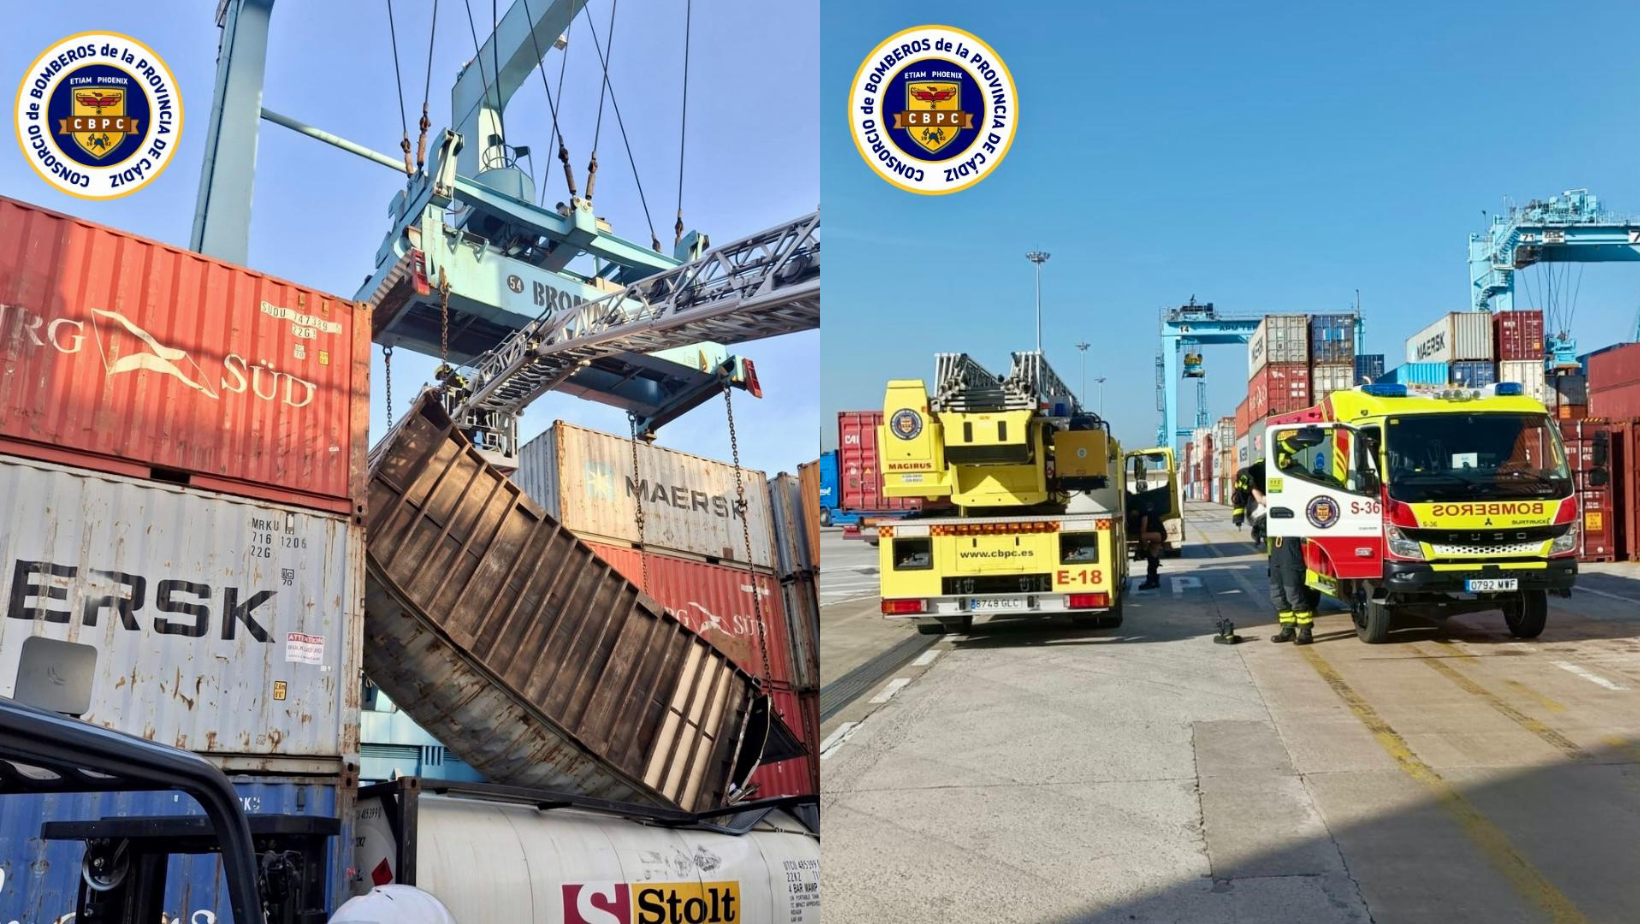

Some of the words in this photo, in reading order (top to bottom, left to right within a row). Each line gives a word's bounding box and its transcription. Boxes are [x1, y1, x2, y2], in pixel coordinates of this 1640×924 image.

[509, 276, 521, 292] 54
[262, 302, 286, 318] SUDU
[1416, 331, 1446, 360] MAERSK
[221, 353, 317, 408] SÜD
[625, 475, 747, 520] MAERSK
[1351, 501, 1381, 515] S-36
[252, 517, 279, 531] MRKU
[252, 532, 272, 544] 716
[281, 536, 307, 549] 1206
[251, 545, 271, 558] 22G
[960, 549, 1034, 559] www.cbpc.es
[1057, 570, 1103, 585] E-18
[1471, 580, 1494, 590] 0792
[7, 558, 278, 643] ERSK
[1001, 598, 1020, 608] GLC
[638, 888, 735, 924] Stolt
